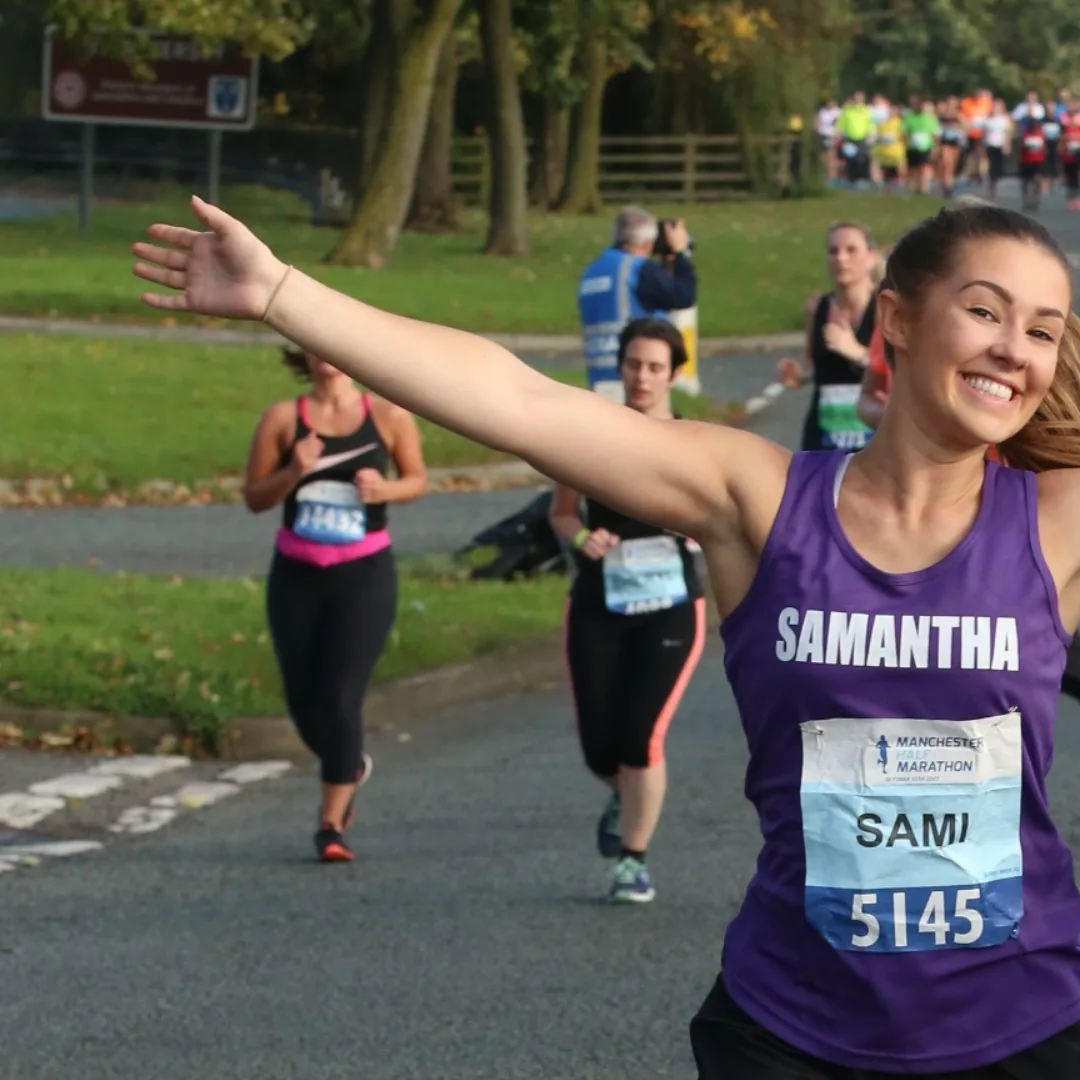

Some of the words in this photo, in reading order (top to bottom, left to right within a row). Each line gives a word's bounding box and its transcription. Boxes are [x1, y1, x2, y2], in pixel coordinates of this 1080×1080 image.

[776, 607, 1019, 671] SAMANTHA
[896, 736, 984, 749] MANCHESTER
[896, 760, 973, 773] MARATHON
[856, 812, 969, 848] SAMI
[851, 888, 984, 947] 5145
